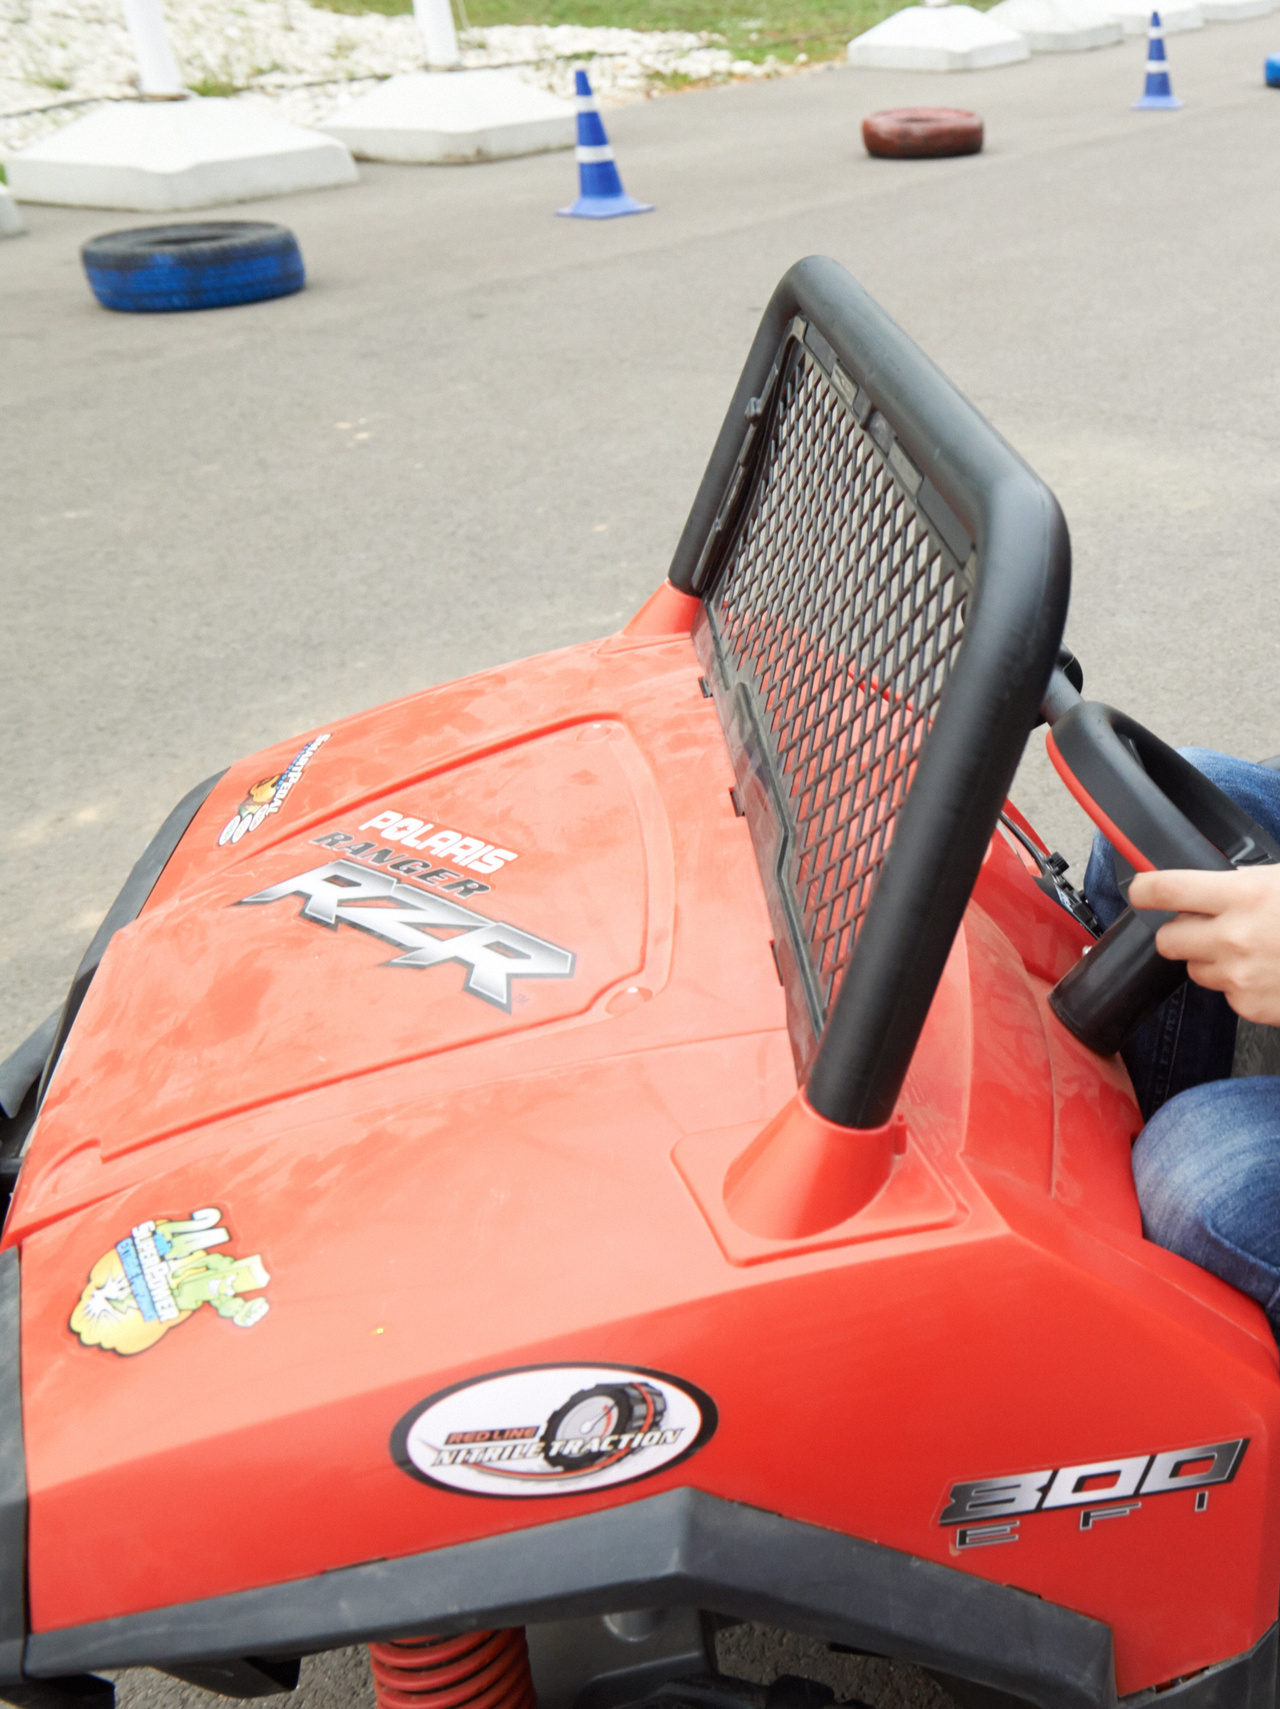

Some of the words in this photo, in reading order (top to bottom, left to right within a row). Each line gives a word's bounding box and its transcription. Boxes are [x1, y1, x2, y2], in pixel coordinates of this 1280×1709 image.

[309, 831, 492, 900] RANGER
[358, 810, 519, 874] POLARIS
[231, 859, 577, 1014] RZR
[432, 1441, 546, 1467] NITRILE
[547, 1427, 685, 1457] TRACTION
[448, 1430, 494, 1444] RED
[494, 1427, 538, 1442] LINE
[939, 1437, 1250, 1527] 800
